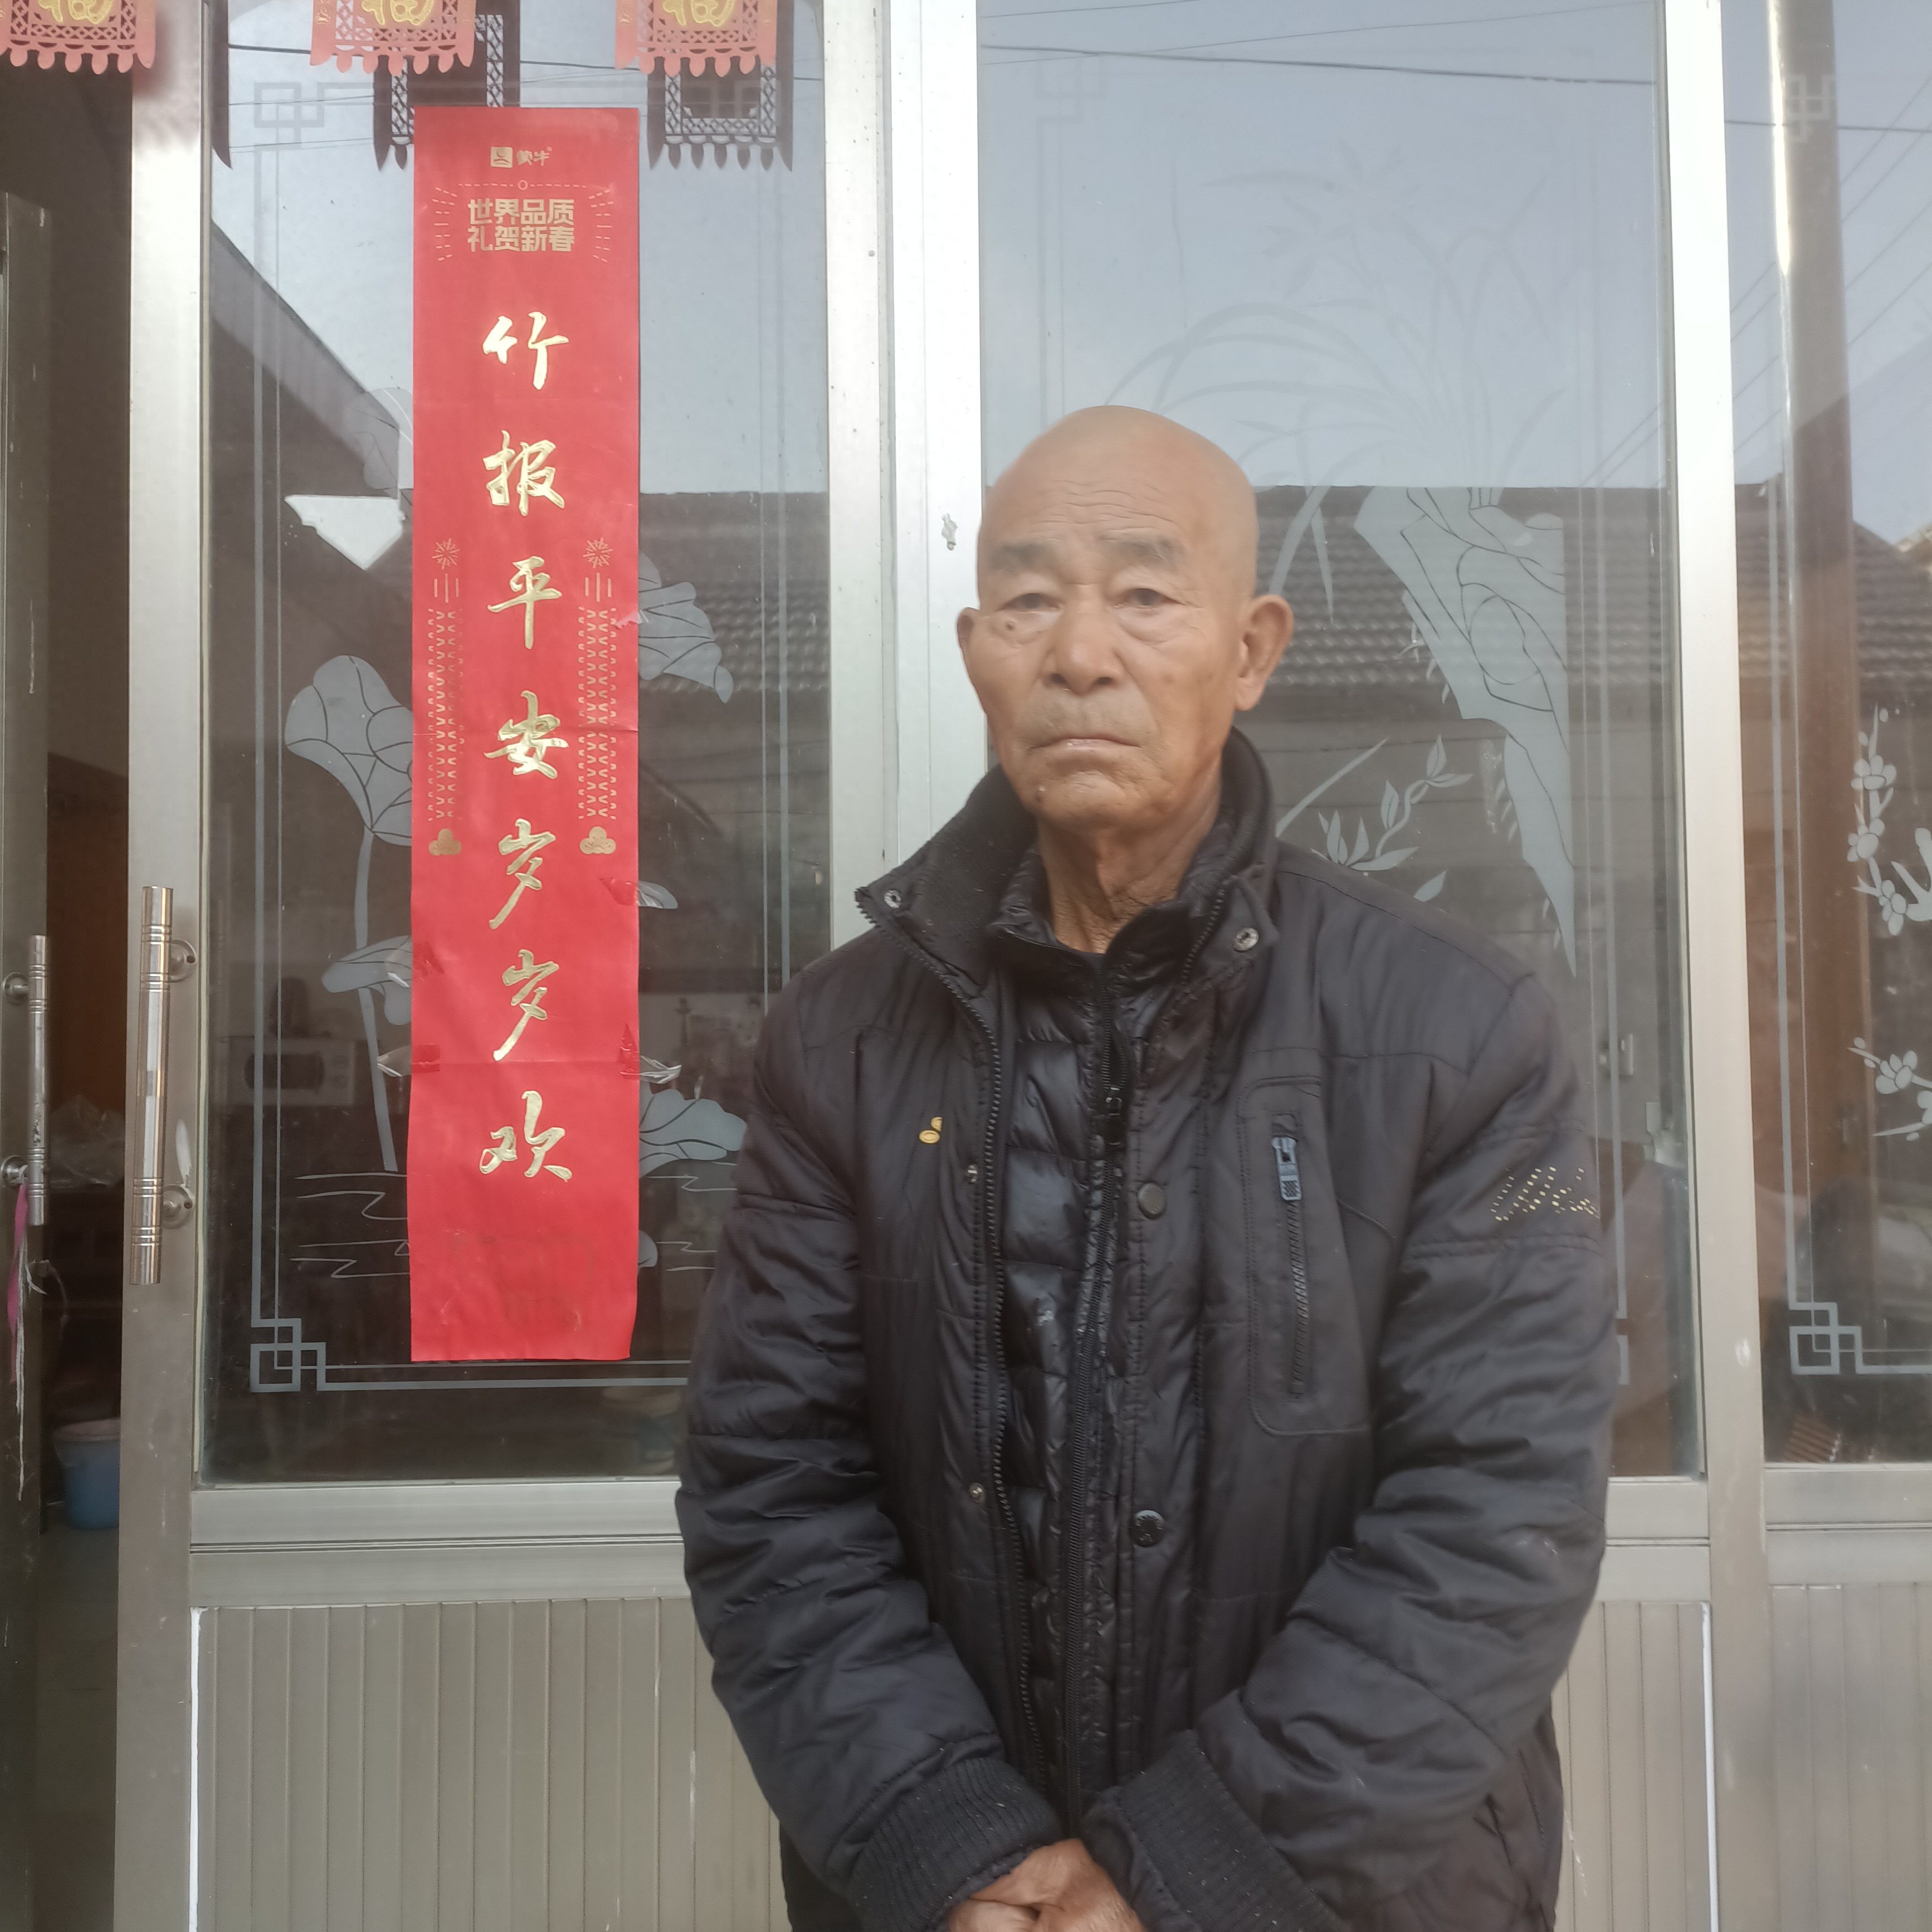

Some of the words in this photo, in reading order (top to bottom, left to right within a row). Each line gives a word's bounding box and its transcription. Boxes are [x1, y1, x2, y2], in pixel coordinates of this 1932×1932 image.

[467, 198, 575, 225] 世界品质
[467, 225, 575, 252] 礼贺新春
[479, 311, 572, 1183] 竹报平安岁岁欢
